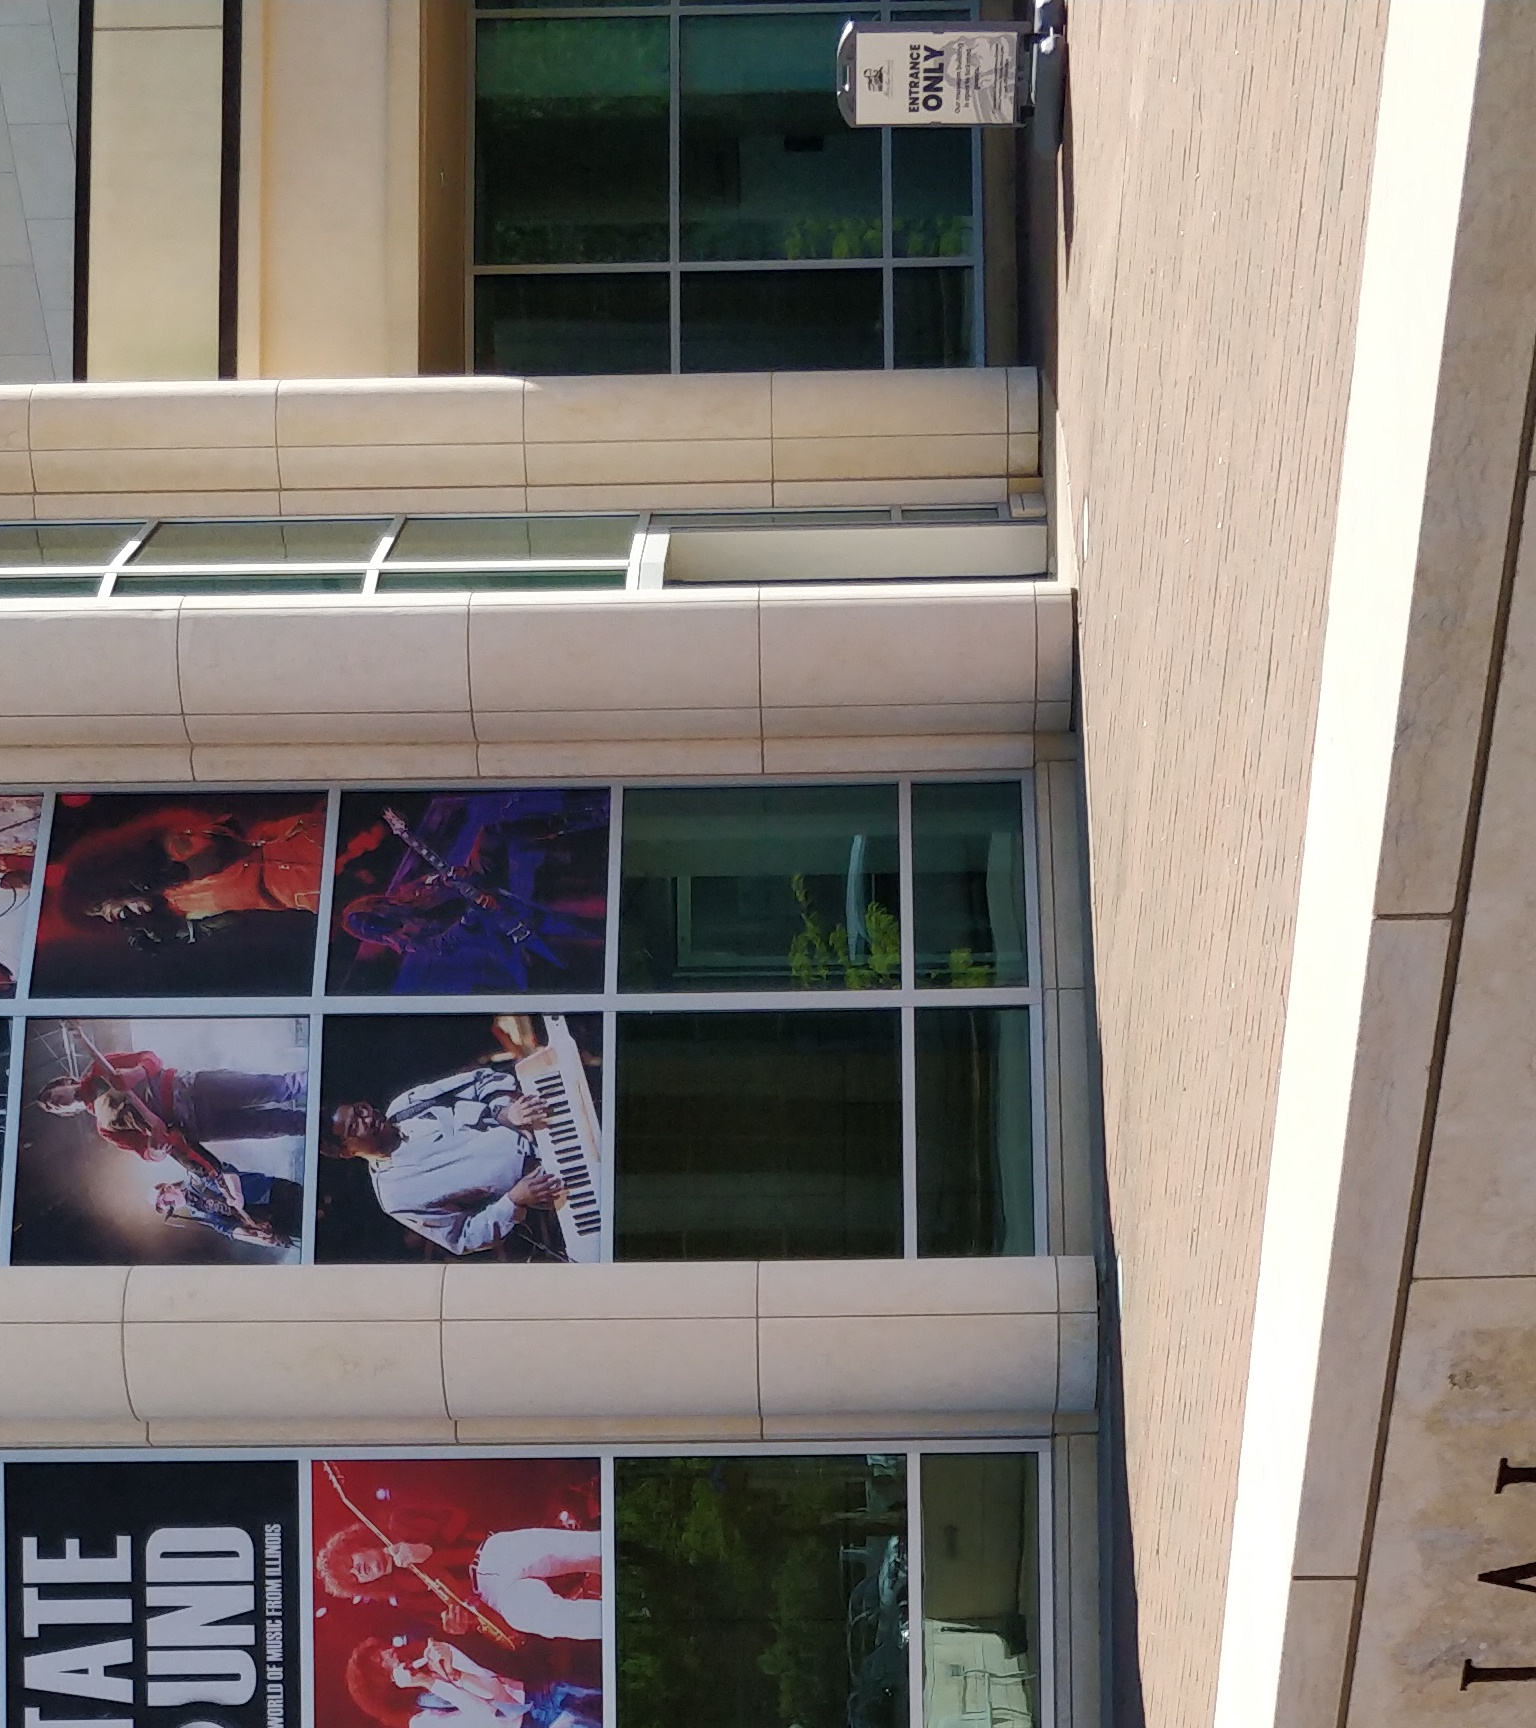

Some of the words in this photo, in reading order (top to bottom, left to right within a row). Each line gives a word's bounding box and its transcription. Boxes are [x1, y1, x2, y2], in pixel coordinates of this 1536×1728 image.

[908, 44, 921, 113] ENTRANCE
[922, 44, 945, 112] ONLY
[265, 1523, 282, 1579] ILLINOIS
[265, 1581, 283, 1617] FROM
[266, 1619, 284, 1661] MUSIC
[266, 1661, 284, 1682] OF
